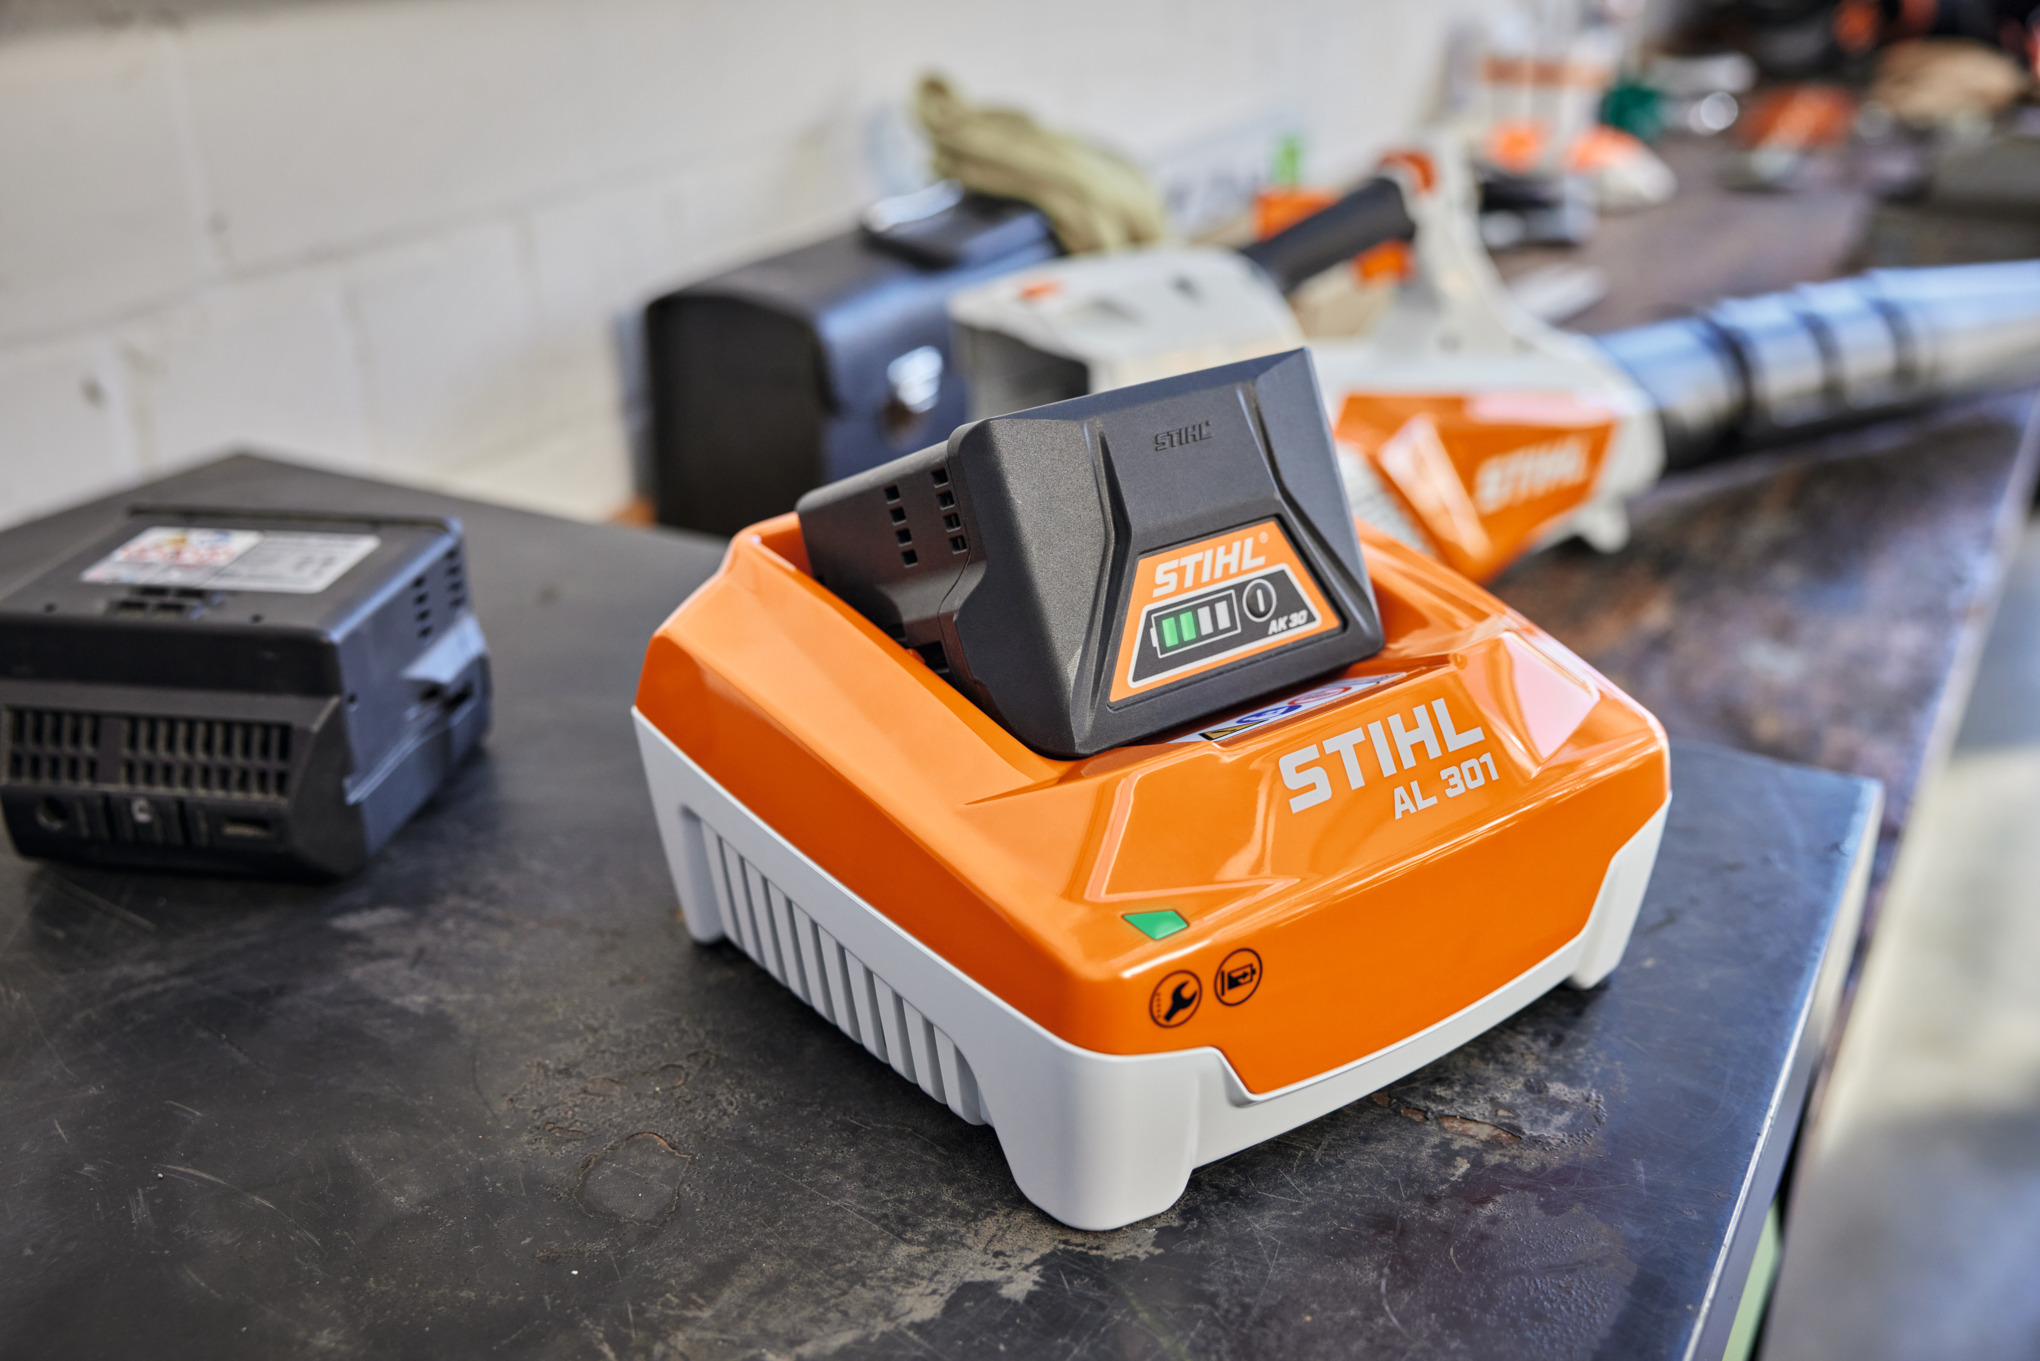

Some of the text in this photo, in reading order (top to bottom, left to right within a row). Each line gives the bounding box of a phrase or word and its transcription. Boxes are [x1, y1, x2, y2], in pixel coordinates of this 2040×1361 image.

[1154, 421, 1212, 451] STIHL
[1268, 609, 1308, 635] AK 30
[1278, 698, 1485, 814] STIHL
[1394, 752, 1499, 820] AL 301
